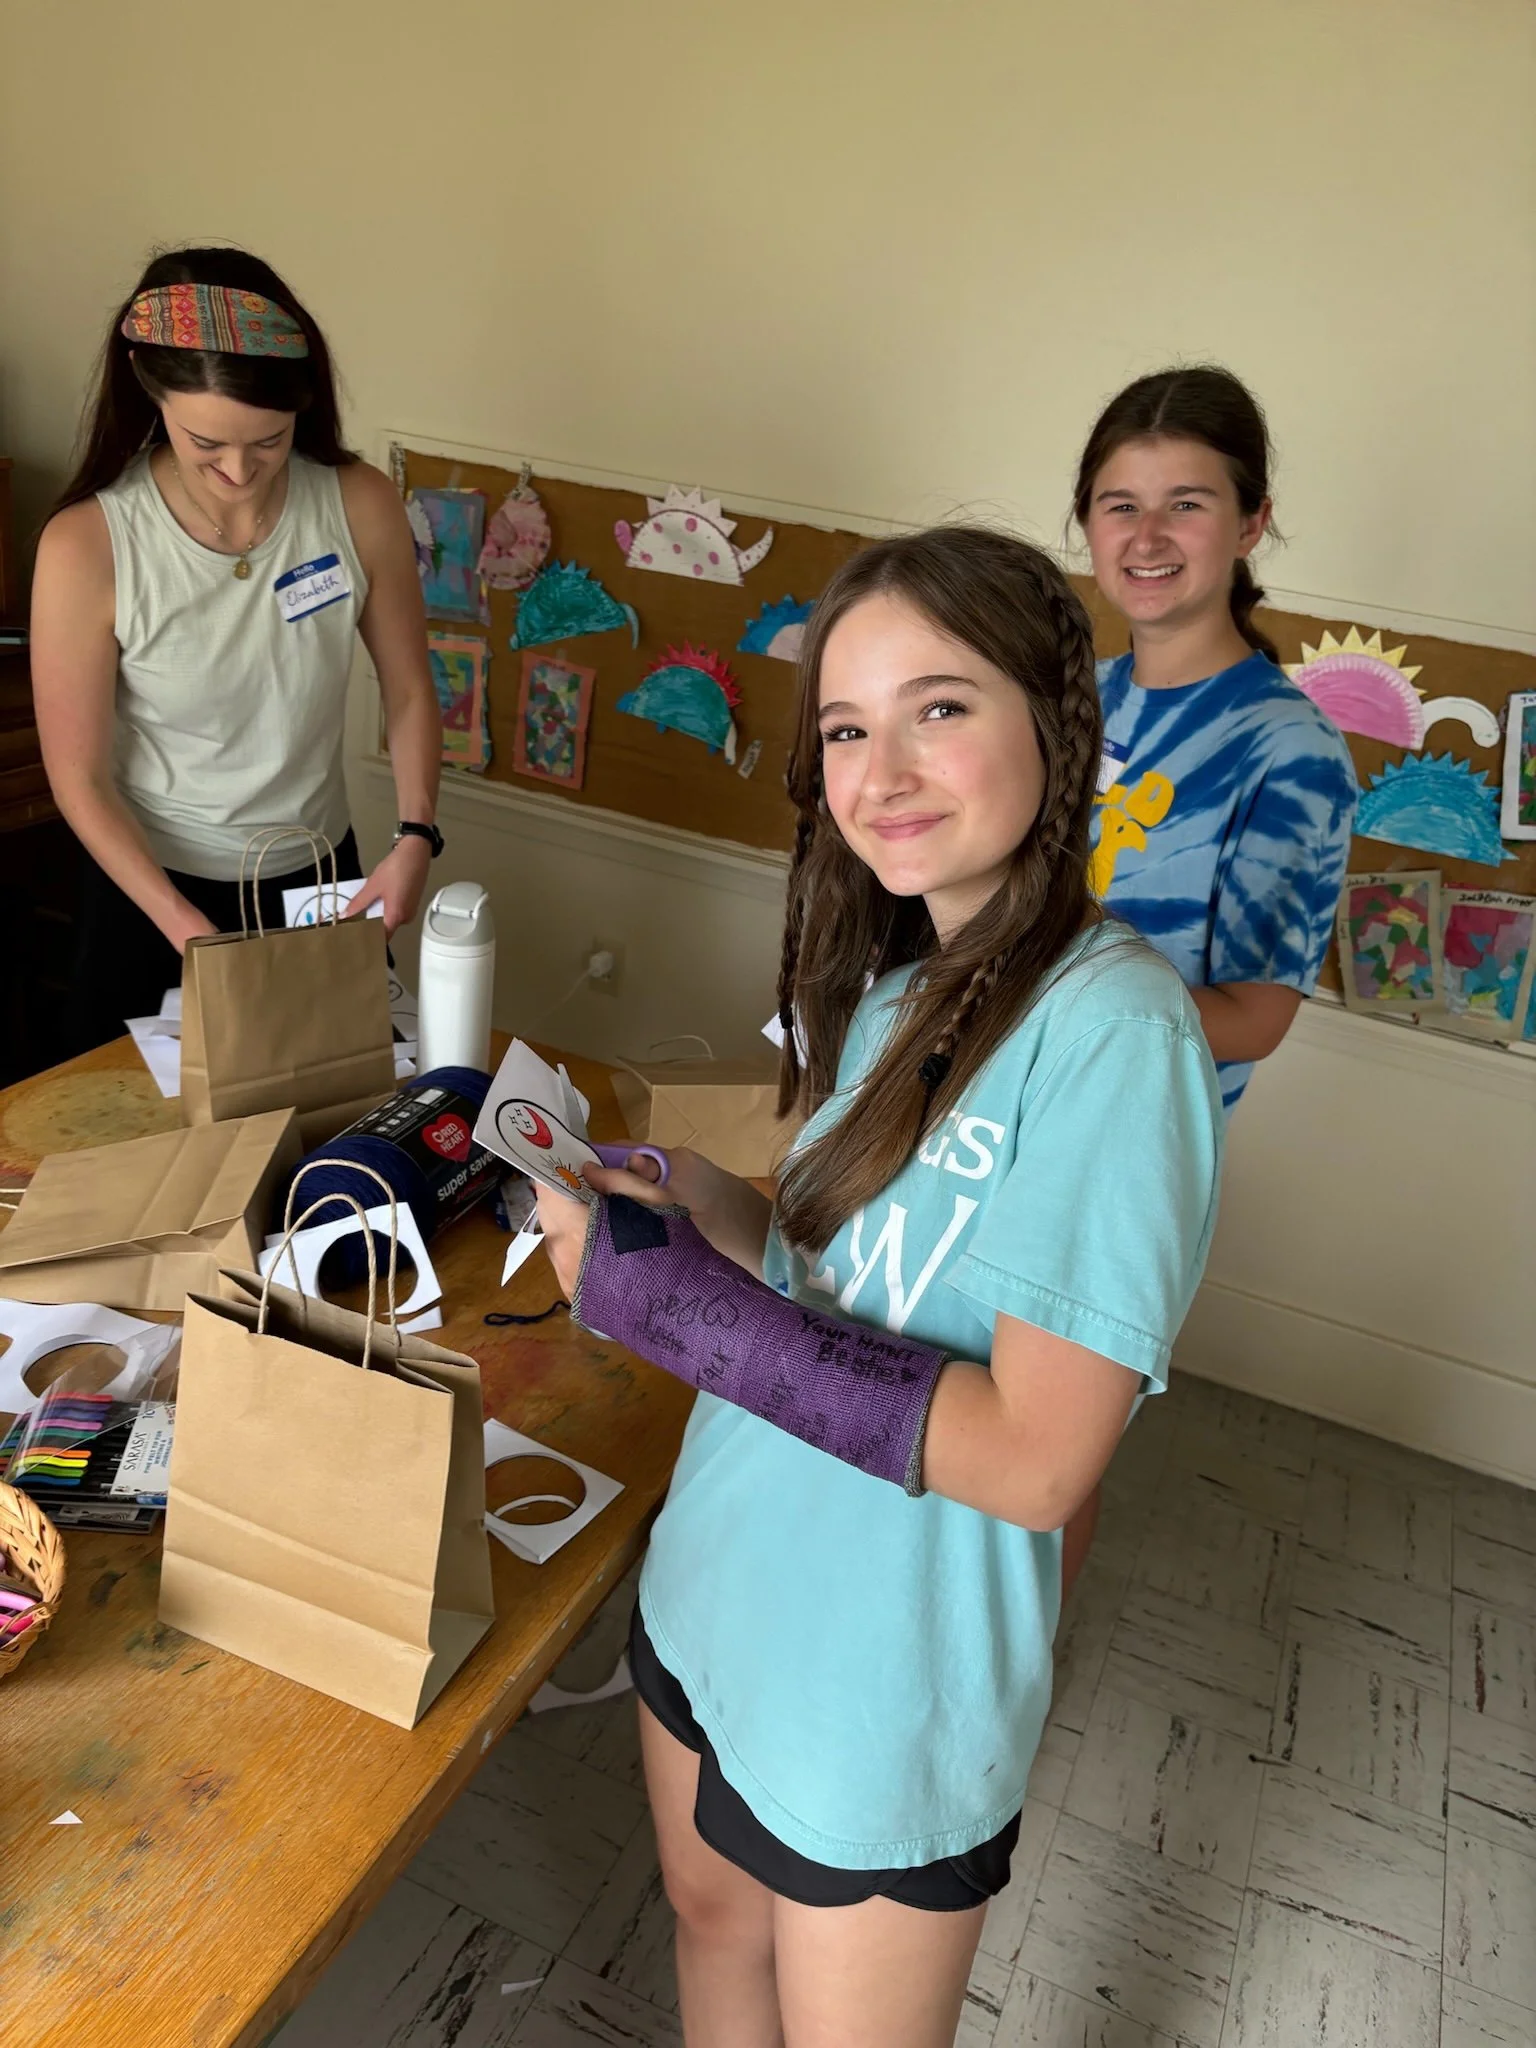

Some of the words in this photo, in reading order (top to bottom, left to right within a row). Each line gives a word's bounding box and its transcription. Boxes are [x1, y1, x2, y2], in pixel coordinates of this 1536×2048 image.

[292, 564, 316, 578] Hello
[286, 575, 340, 607] Elizabeth
[440, 1130, 466, 1153] HEART
[441, 1122, 459, 1140] RED
[437, 1170, 469, 1202] super
[470, 1149, 498, 1177] save
[123, 1432, 147, 1472] SARASA
